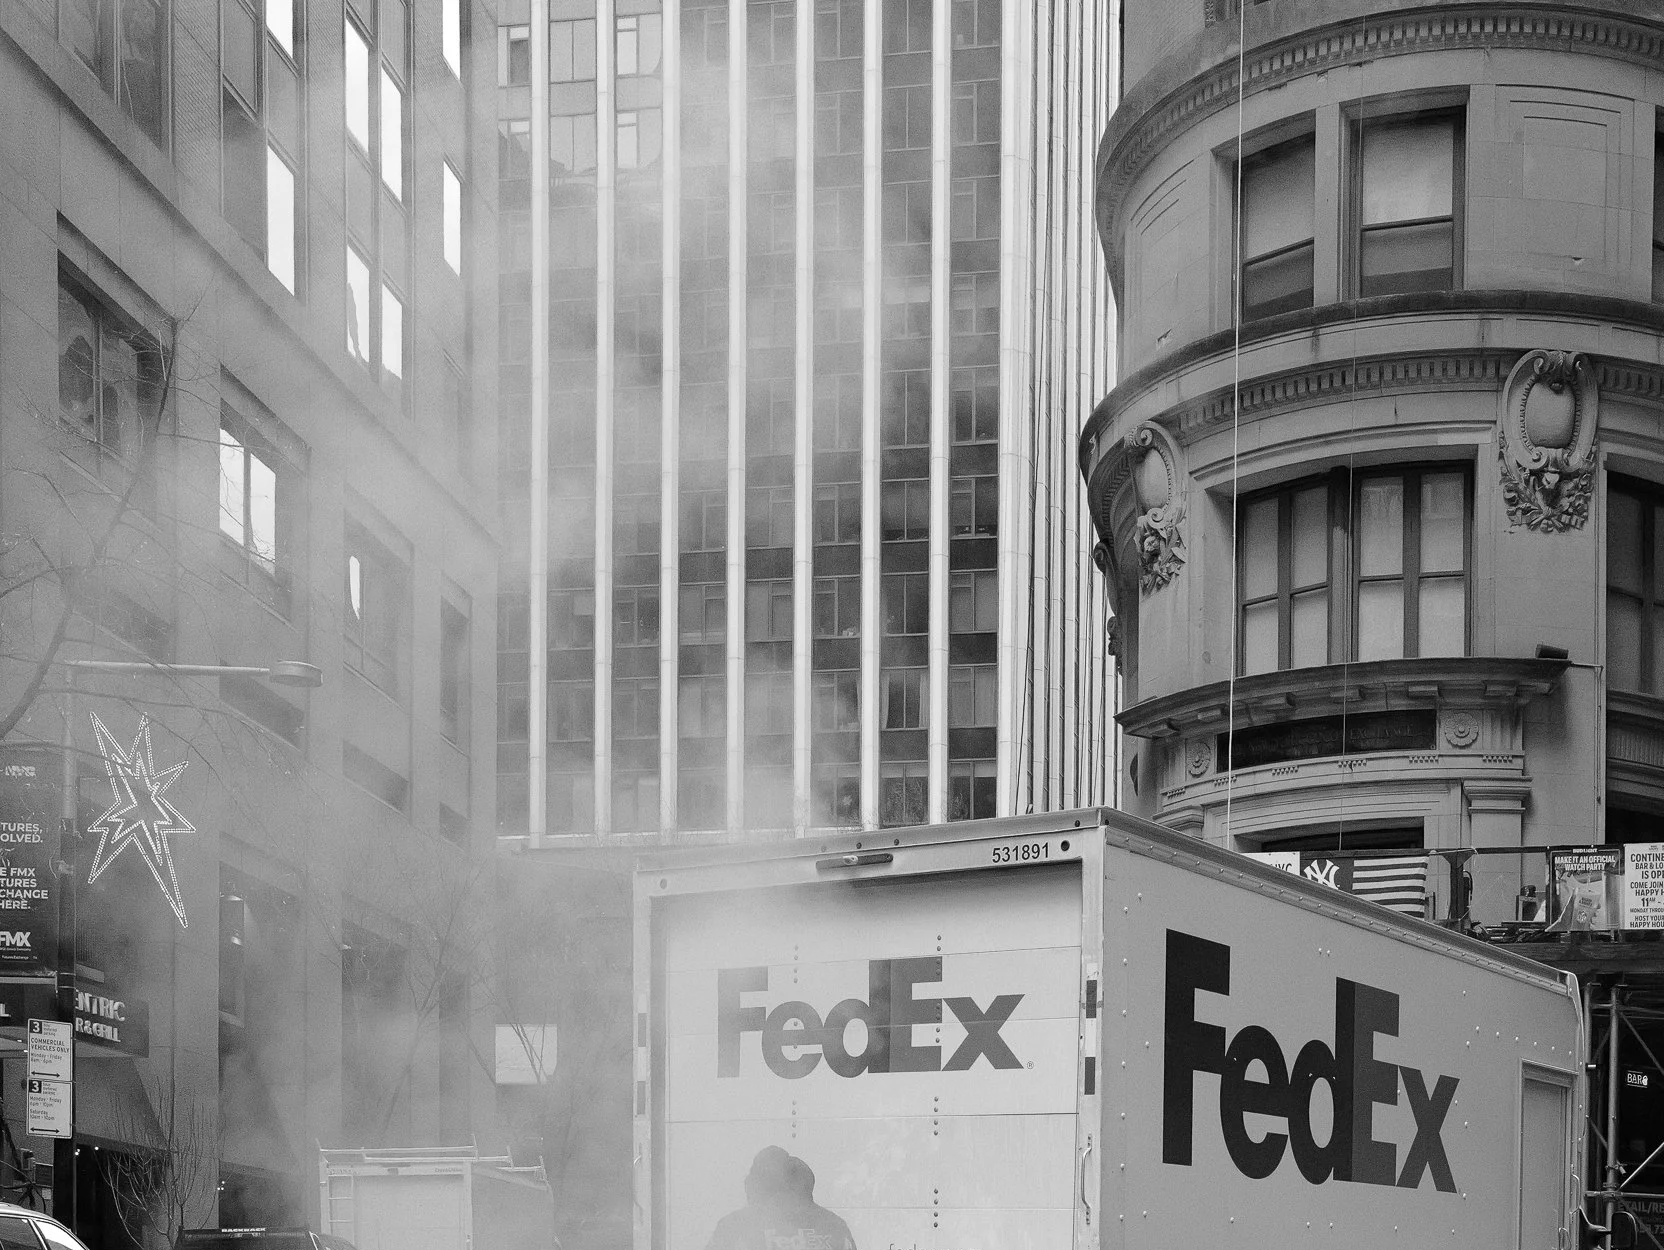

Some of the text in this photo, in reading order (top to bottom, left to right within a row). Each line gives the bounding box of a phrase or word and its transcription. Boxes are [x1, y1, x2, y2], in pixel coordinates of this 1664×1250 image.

[0, 822, 43, 834] TURES,
[0, 833, 43, 843] OLVED.
[992, 842, 1048, 863] 531891
[1554, 855, 1616, 864] MAKE IT AN OFFICIAL
[1564, 863, 1606, 871] WATCH PARTY
[1635, 862, 1649, 870] BAR
[10, 867, 36, 877] FMX
[1641, 870, 1650, 879] IS
[0, 878, 37, 888] TURES
[1630, 881, 1648, 889] COME
[0, 889, 49, 899] CHANGE
[1635, 888, 1659, 897] HAPPY
[1629, 921, 1650, 929] HAPPY
[0, 931, 31, 947] FMX
[717, 956, 1025, 1079] FedEx
[32, 1021, 41, 1033] 3
[31, 1038, 65, 1047] COMMERCIAL
[31, 1044, 56, 1052] VEHICLES
[1162, 928, 1460, 1194] FedEx
[31, 1080, 40, 1093] 3
